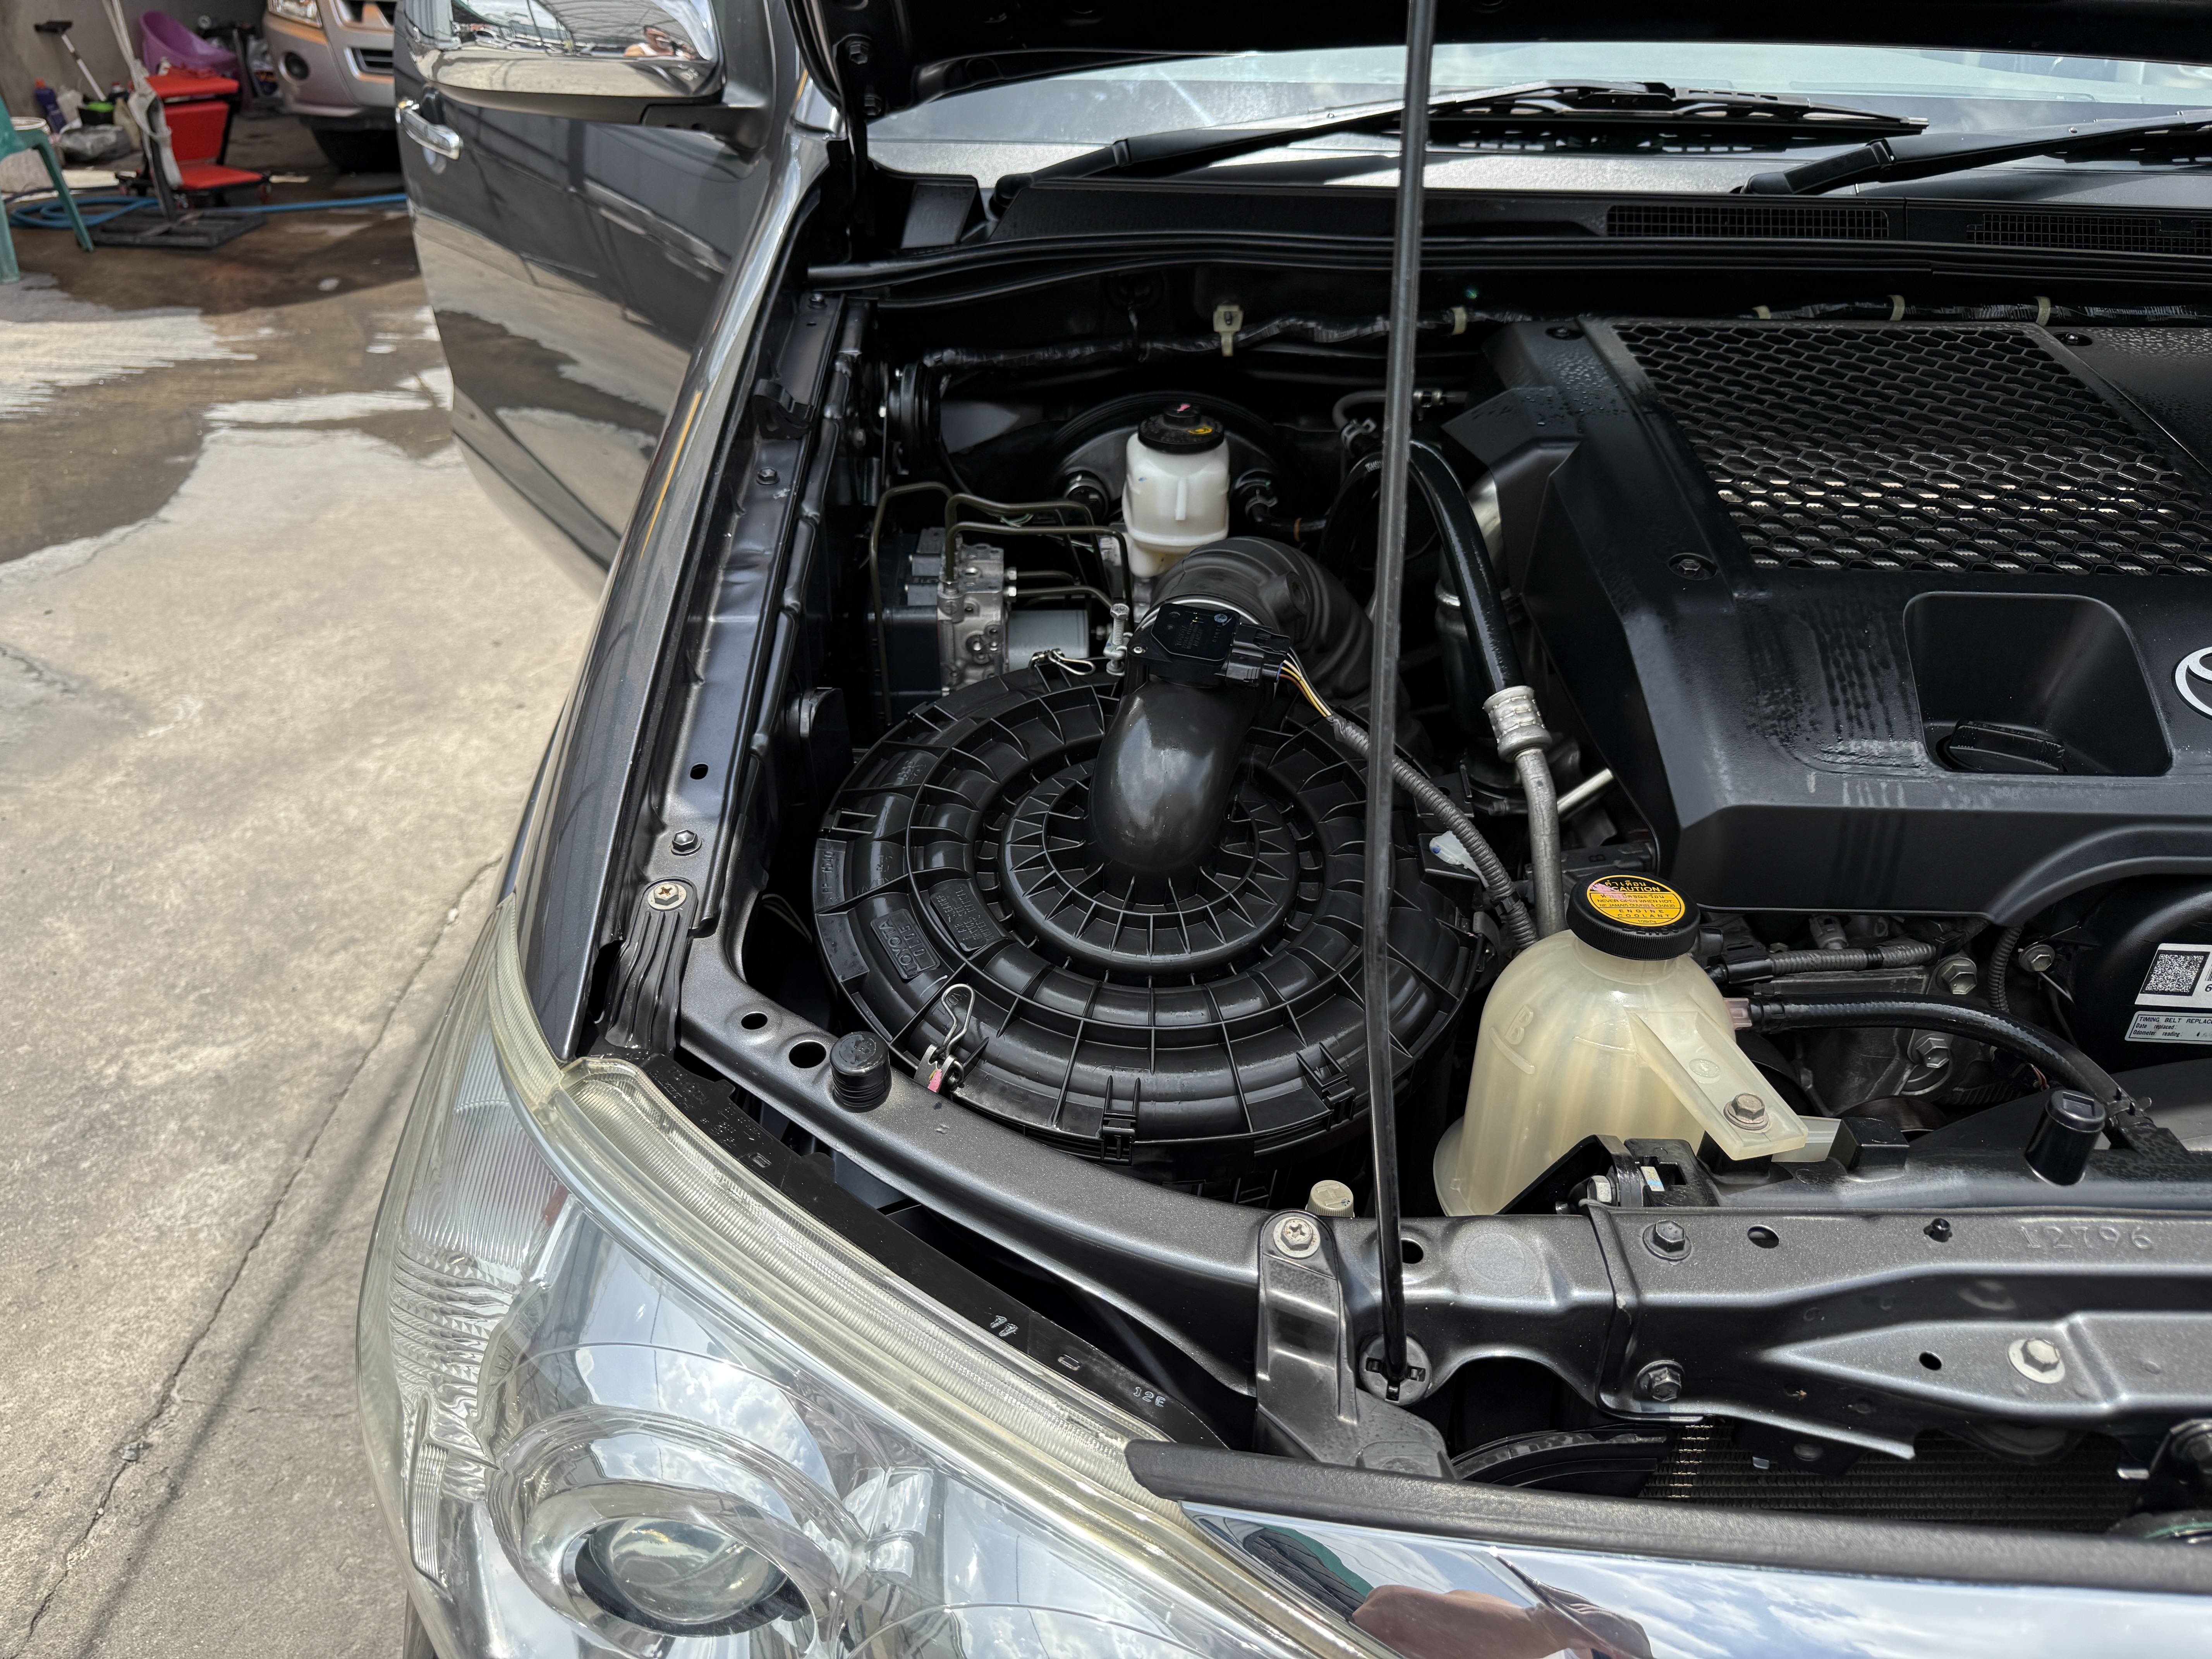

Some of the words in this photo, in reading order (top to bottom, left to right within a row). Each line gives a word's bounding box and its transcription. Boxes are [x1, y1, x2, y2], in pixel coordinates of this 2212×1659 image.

[879, 918, 917, 971] TOYOTA
[2019, 1225, 2153, 1250] 12796
[1132, 1386, 1167, 1408] 12E
